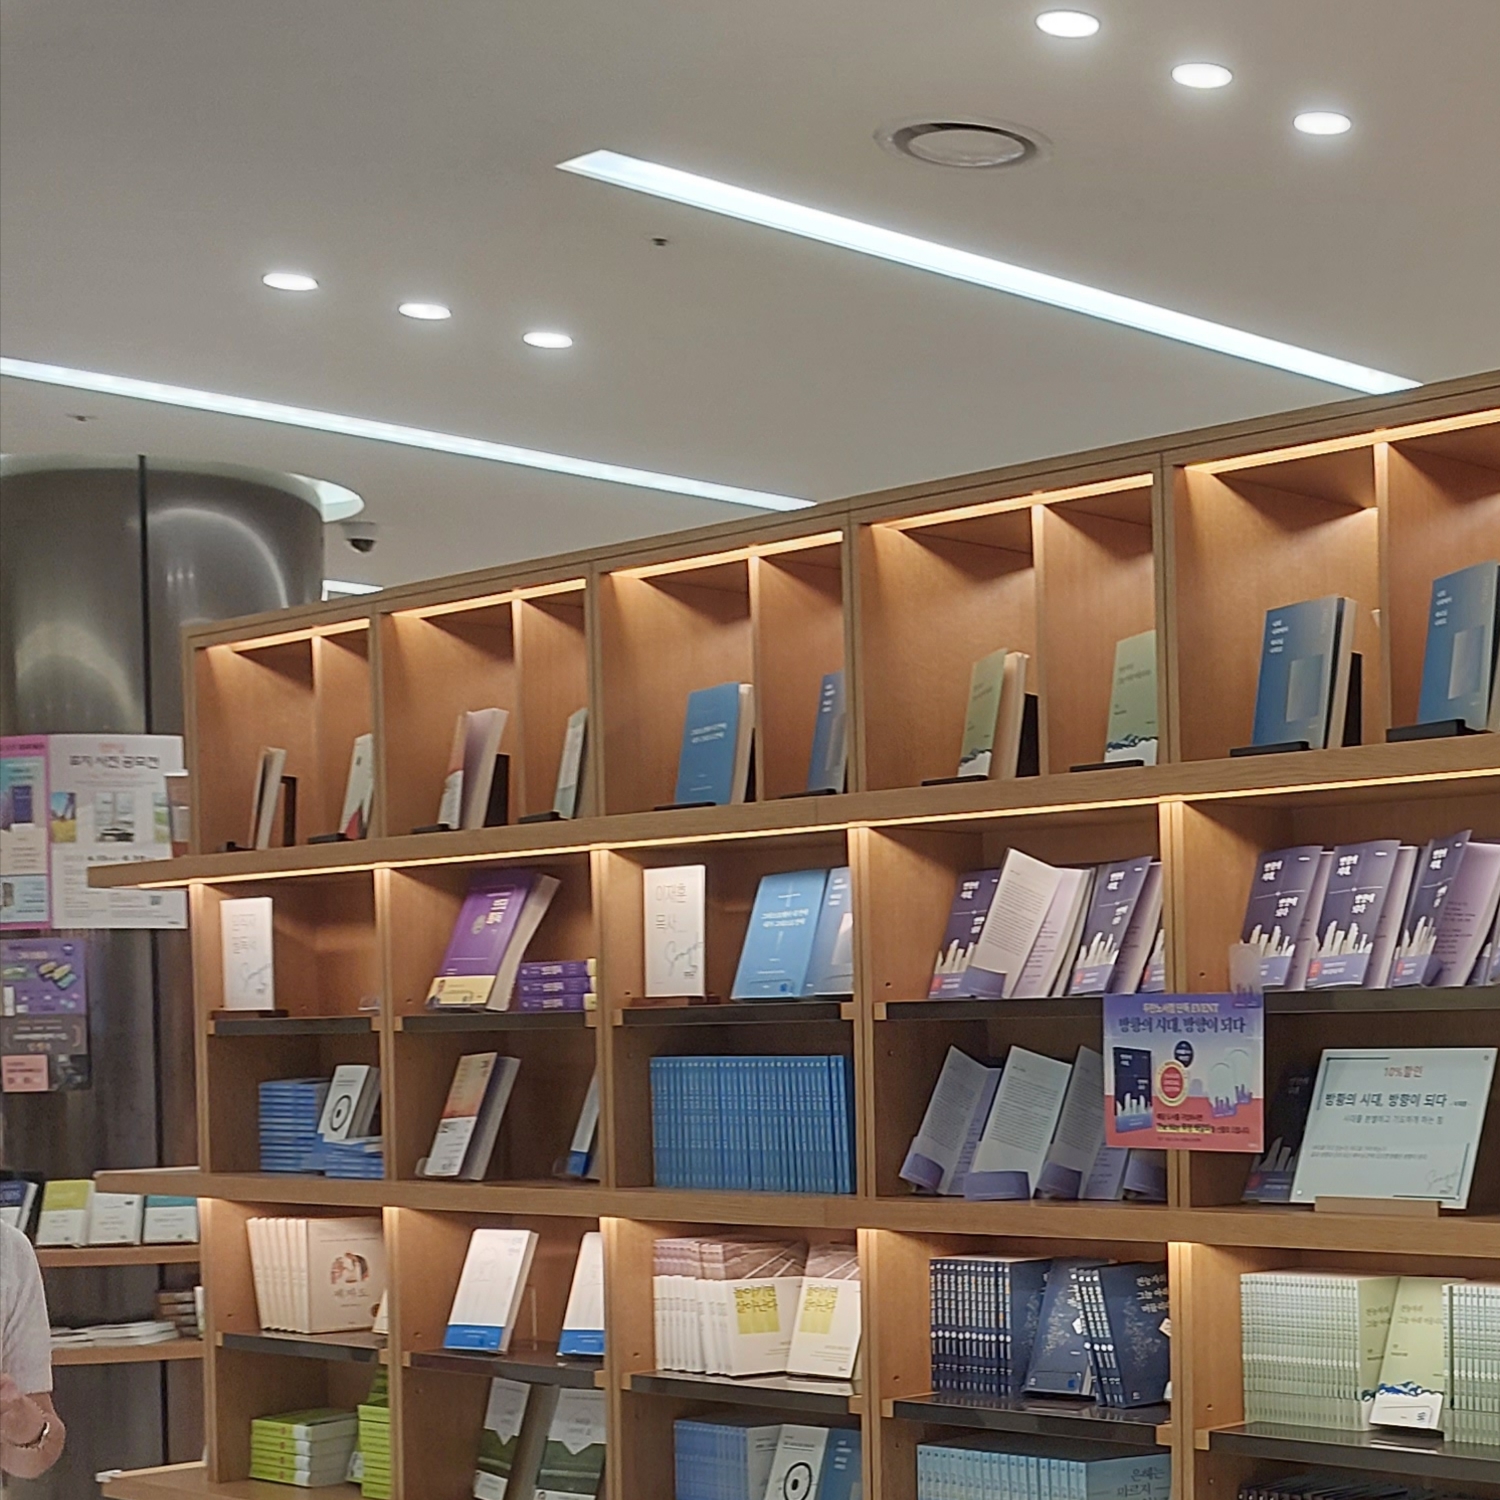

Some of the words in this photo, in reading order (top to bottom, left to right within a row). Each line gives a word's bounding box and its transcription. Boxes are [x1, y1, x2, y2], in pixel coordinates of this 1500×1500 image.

[1220, 1017, 1246, 1033] 되다
[1325, 1093, 1356, 1107] 방황의
[1388, 1093, 1421, 1107] 방향이
[1423, 1093, 1447, 1108] 되다
[1131, 1466, 1166, 1482] 은혜는
[1117, 1483, 1151, 1498] 마르지
